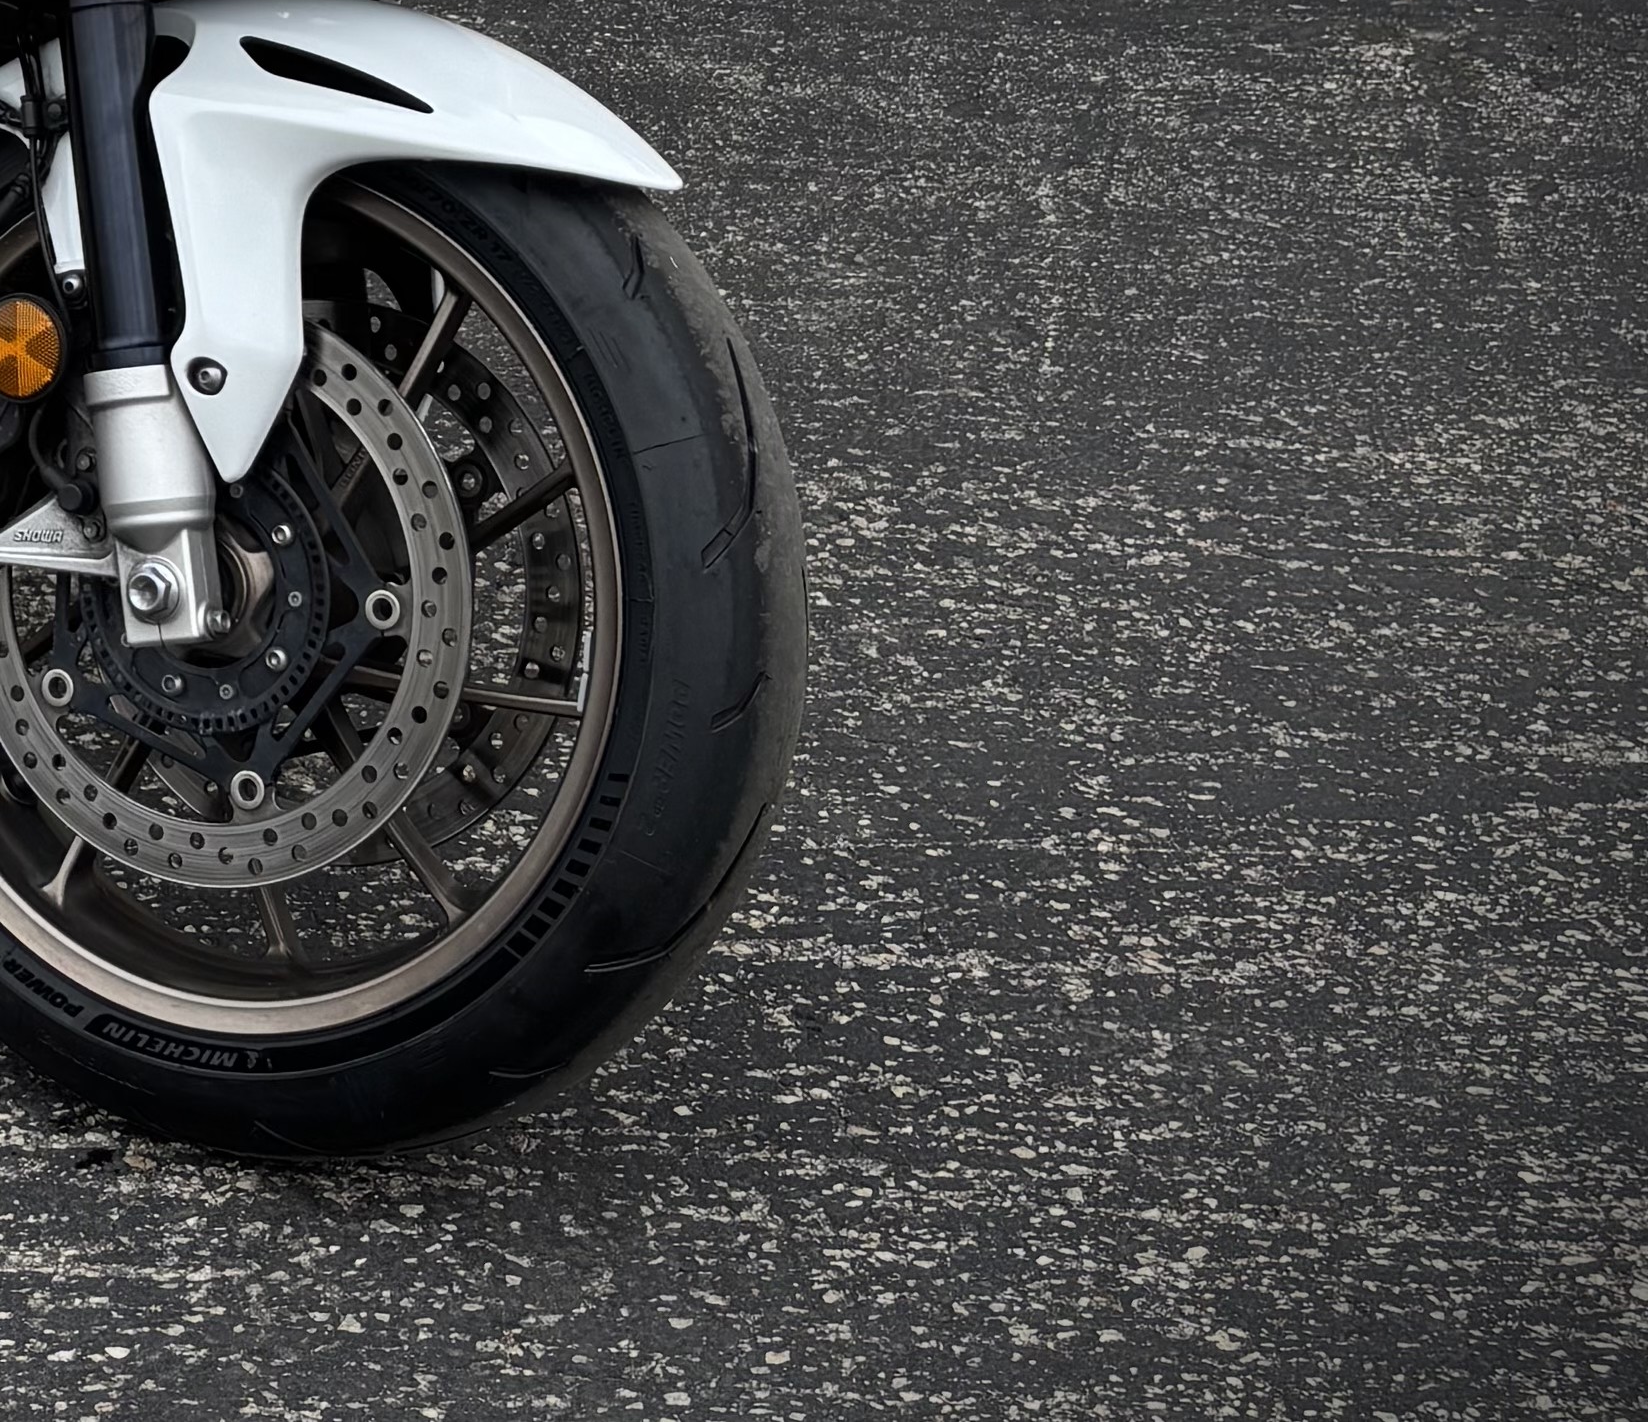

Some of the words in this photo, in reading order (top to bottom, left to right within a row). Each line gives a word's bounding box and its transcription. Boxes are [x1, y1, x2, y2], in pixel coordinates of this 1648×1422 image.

[13, 529, 65, 544] SHOWA
[1, 951, 86, 1019] POWER
[101, 1019, 240, 1069] MICHELIN
